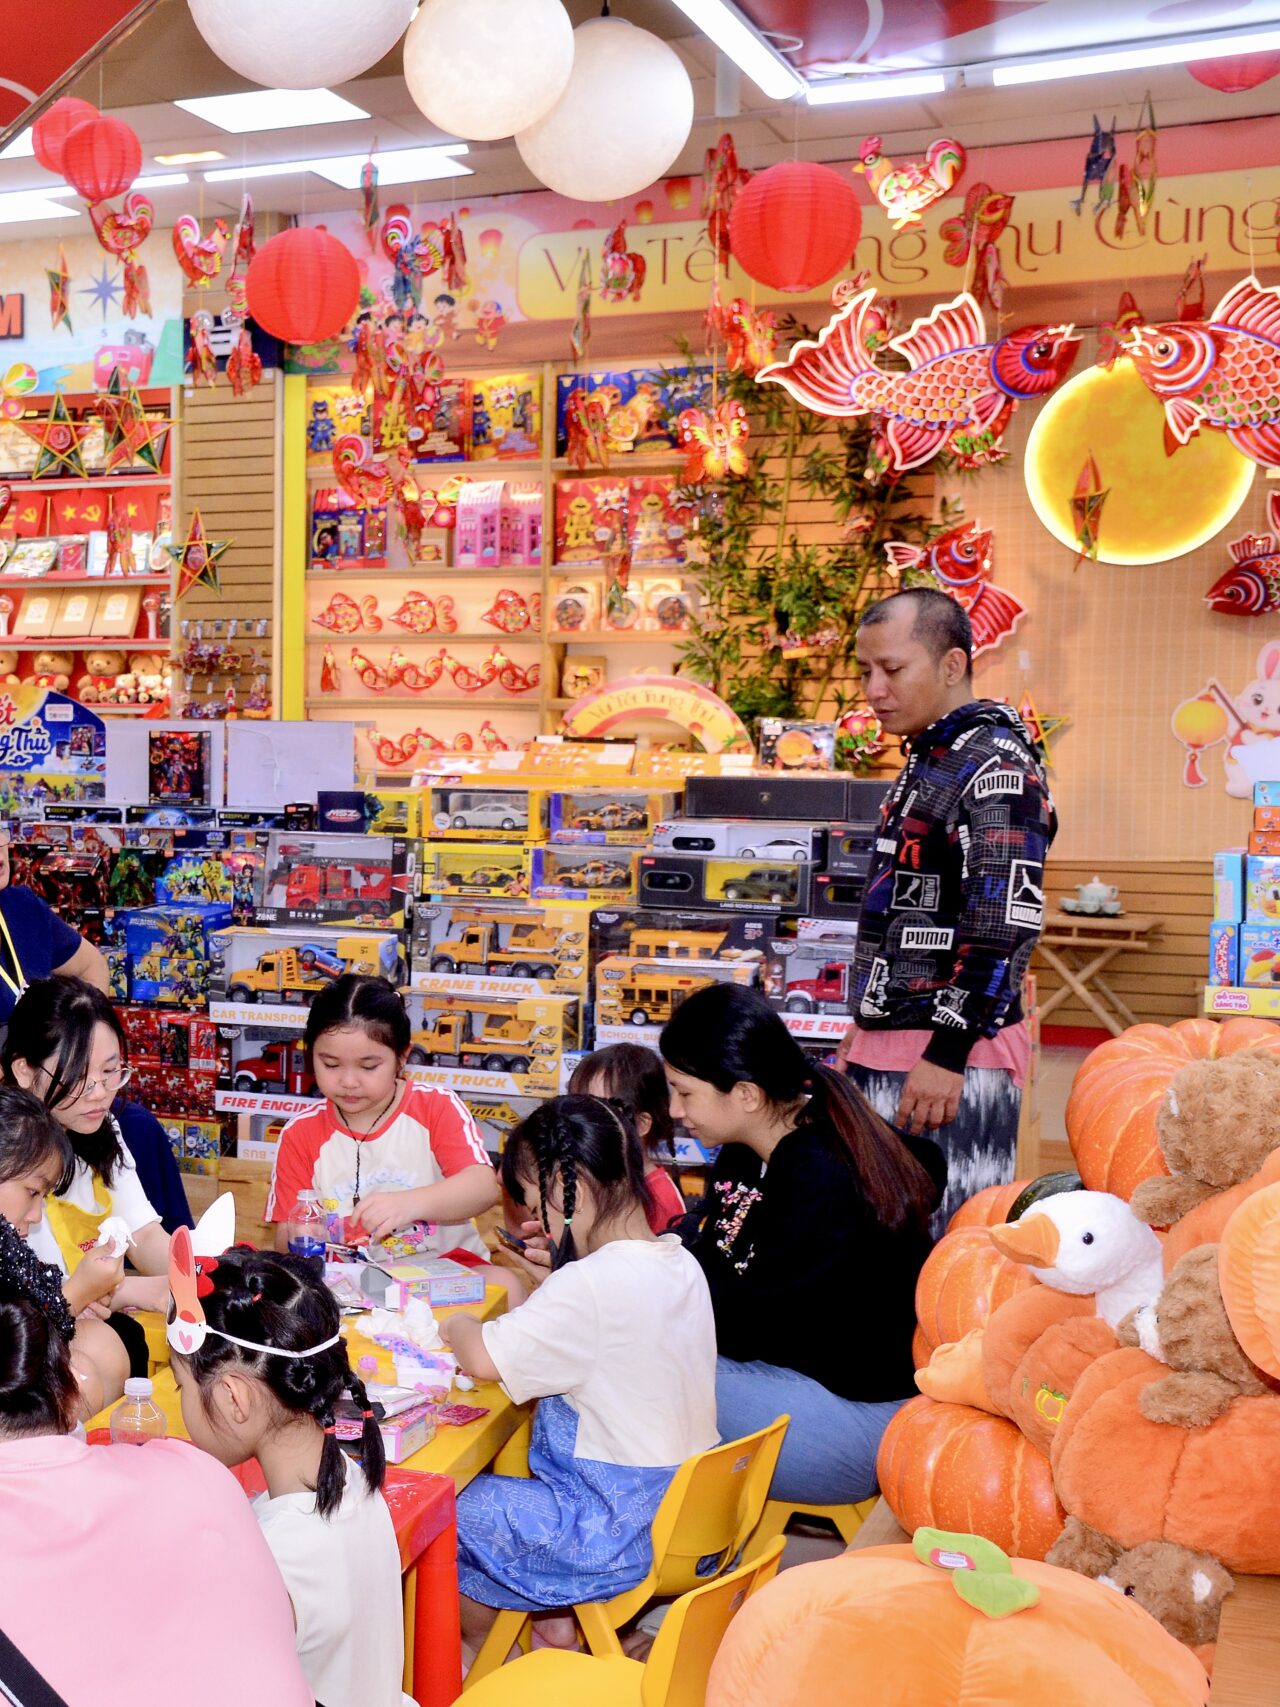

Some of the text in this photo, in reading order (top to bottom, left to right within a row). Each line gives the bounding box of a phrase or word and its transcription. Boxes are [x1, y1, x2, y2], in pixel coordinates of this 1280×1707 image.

[977, 774, 1020, 794] PUMA
[924, 877, 937, 908] PUMA
[904, 931, 950, 946] PUMA
[419, 978, 476, 991] CRANE
[479, 979, 535, 994] TRUCK
[212, 1009, 307, 1023] CAR TRANSPOR
[783, 1019, 815, 1031] IRE
[600, 1031, 640, 1040] SCHOOL
[402, 1071, 507, 1088] RANE TRUCK
[222, 1097, 312, 1112] FIRE ENGIN
